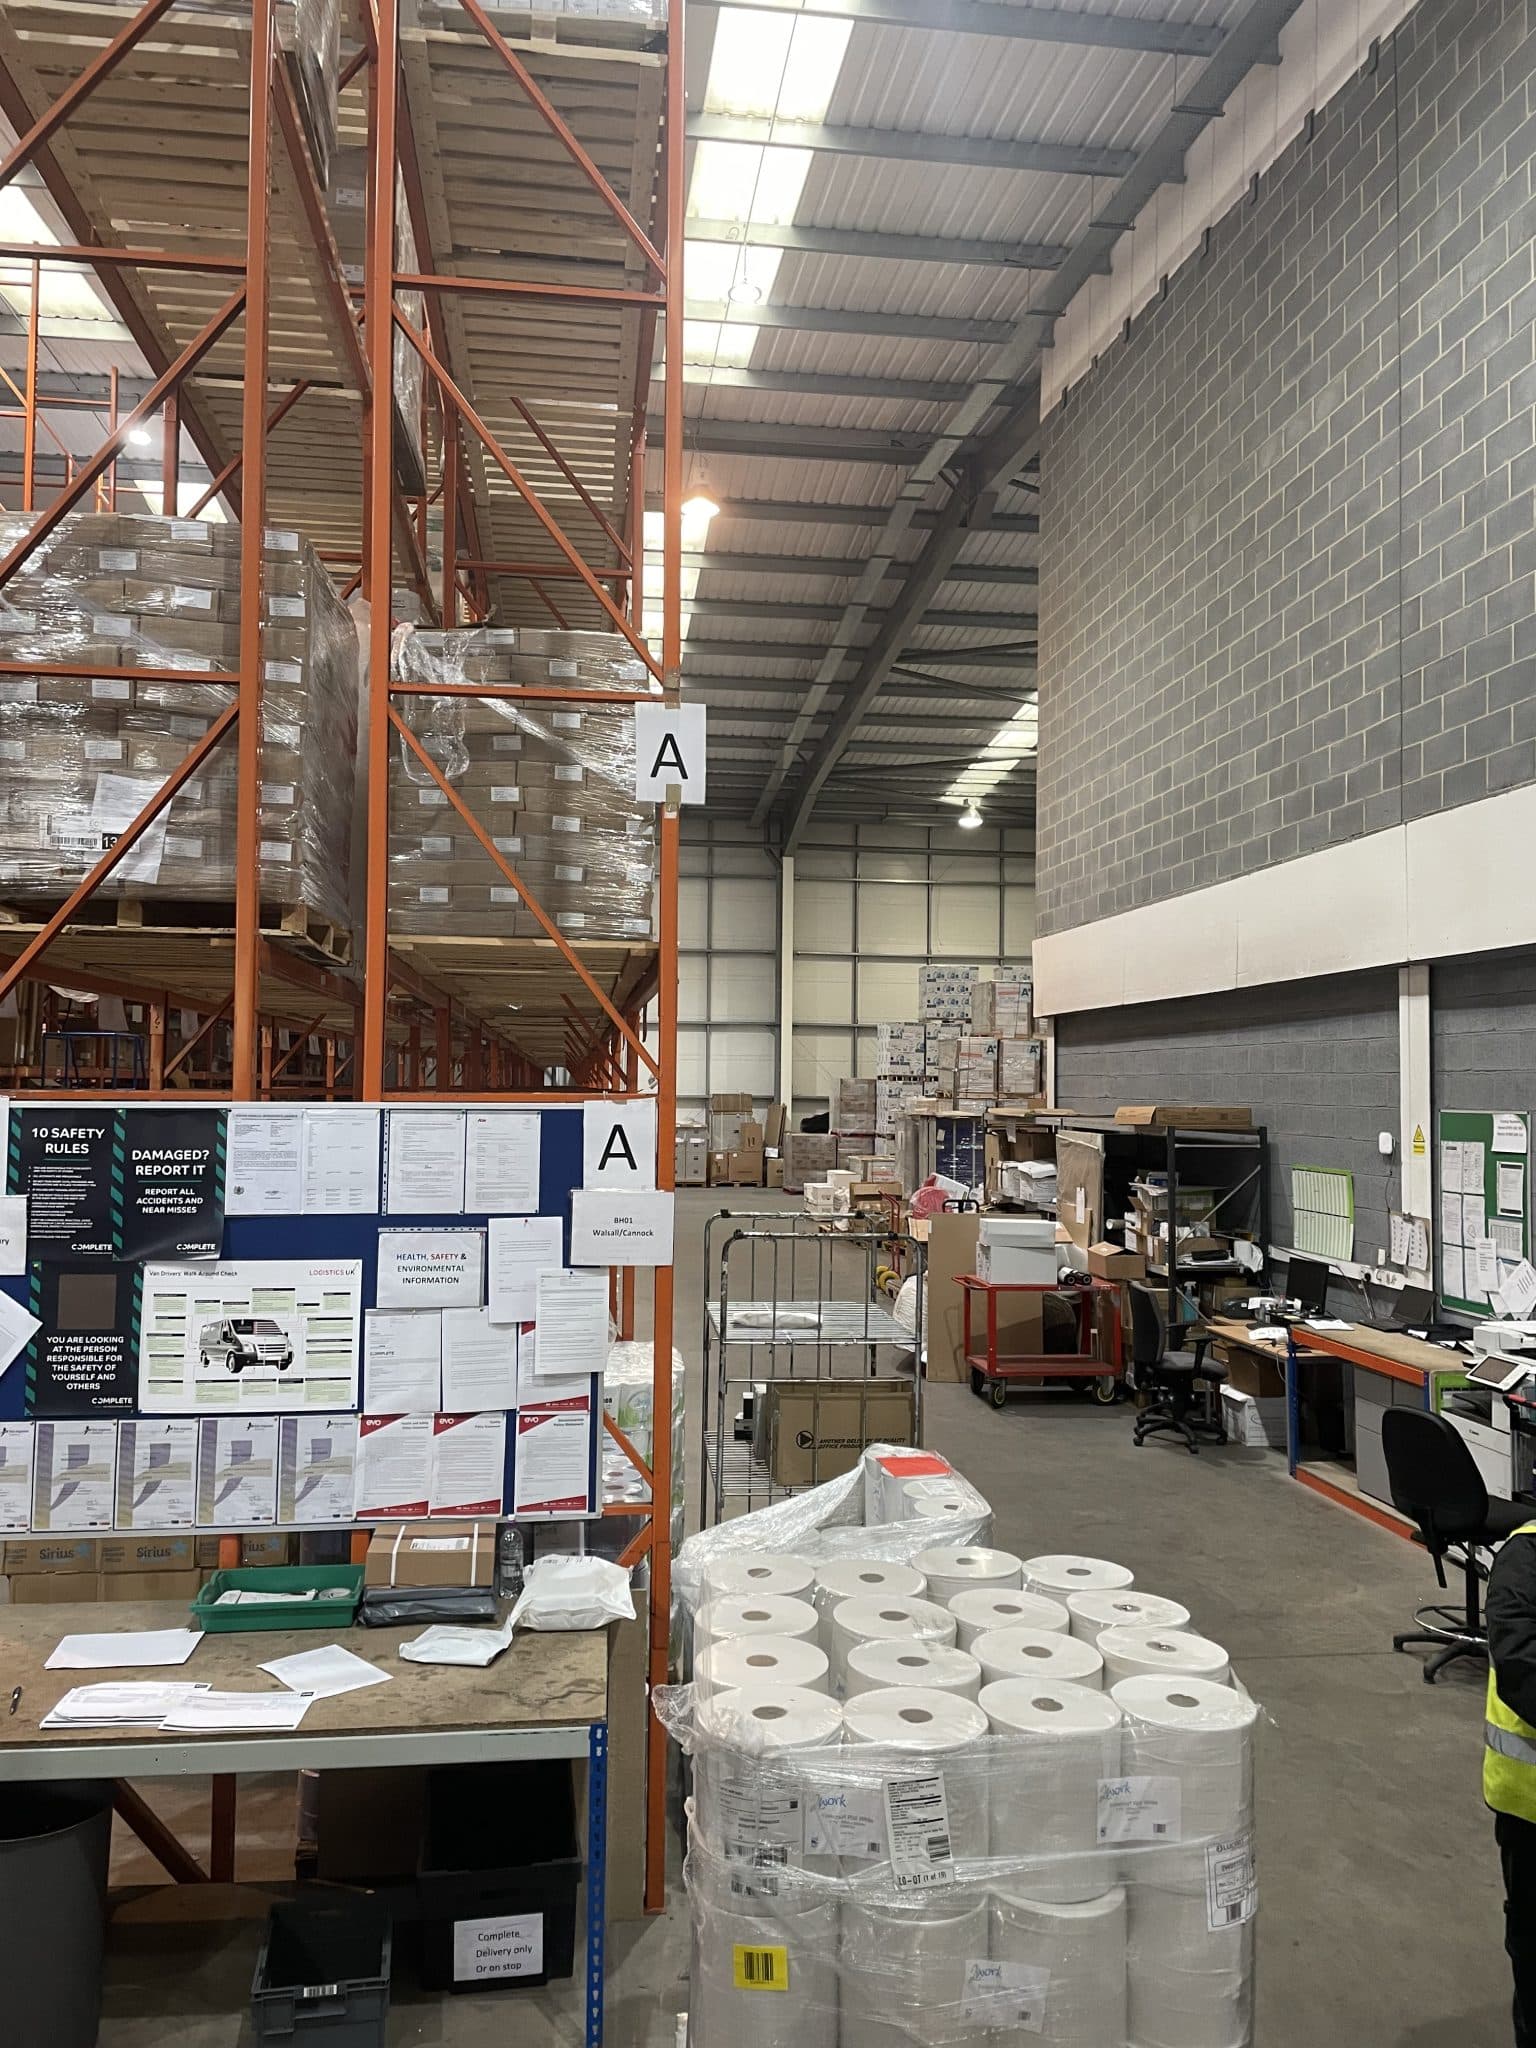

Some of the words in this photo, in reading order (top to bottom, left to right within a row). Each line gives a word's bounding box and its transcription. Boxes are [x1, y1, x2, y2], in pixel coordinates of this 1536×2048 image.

[650, 733, 689, 780] A
[32, 1128, 48, 1138] 10
[51, 1128, 105, 1139] SAFETY
[45, 1143, 90, 1154] RULES
[597, 1124, 638, 1171] A
[132, 1150, 210, 1160] DAMAGED?
[135, 1165, 190, 1176] REPORT
[192, 1165, 206, 1176] IT
[136, 1197, 184, 1205] ACCIDENTS
[142, 1206, 166, 1214] NEAR
[166, 1206, 197, 1214] MISSES
[592, 1228, 654, 1237] Walsall/Cannock
[71, 1243, 112, 1251] COMPLETE
[396, 1253, 429, 1261] HEALTH,
[397, 1265, 465, 1273] ENVIRONMENTAL
[70, 1364, 103, 1372] SAFETY
[51, 1373, 96, 1381] YOURSELF
[524, 1416, 539, 1424] evo
[40, 1547, 74, 1559] Sirius
[136, 1545, 171, 1558] Sirius
[478, 1930, 520, 1941] Complete
[476, 1947, 511, 1958] Delivery
[513, 1945, 533, 1954] only
[476, 1965, 487, 1973] Or
[489, 1964, 500, 1972] on
[503, 1962, 521, 1971] stop
